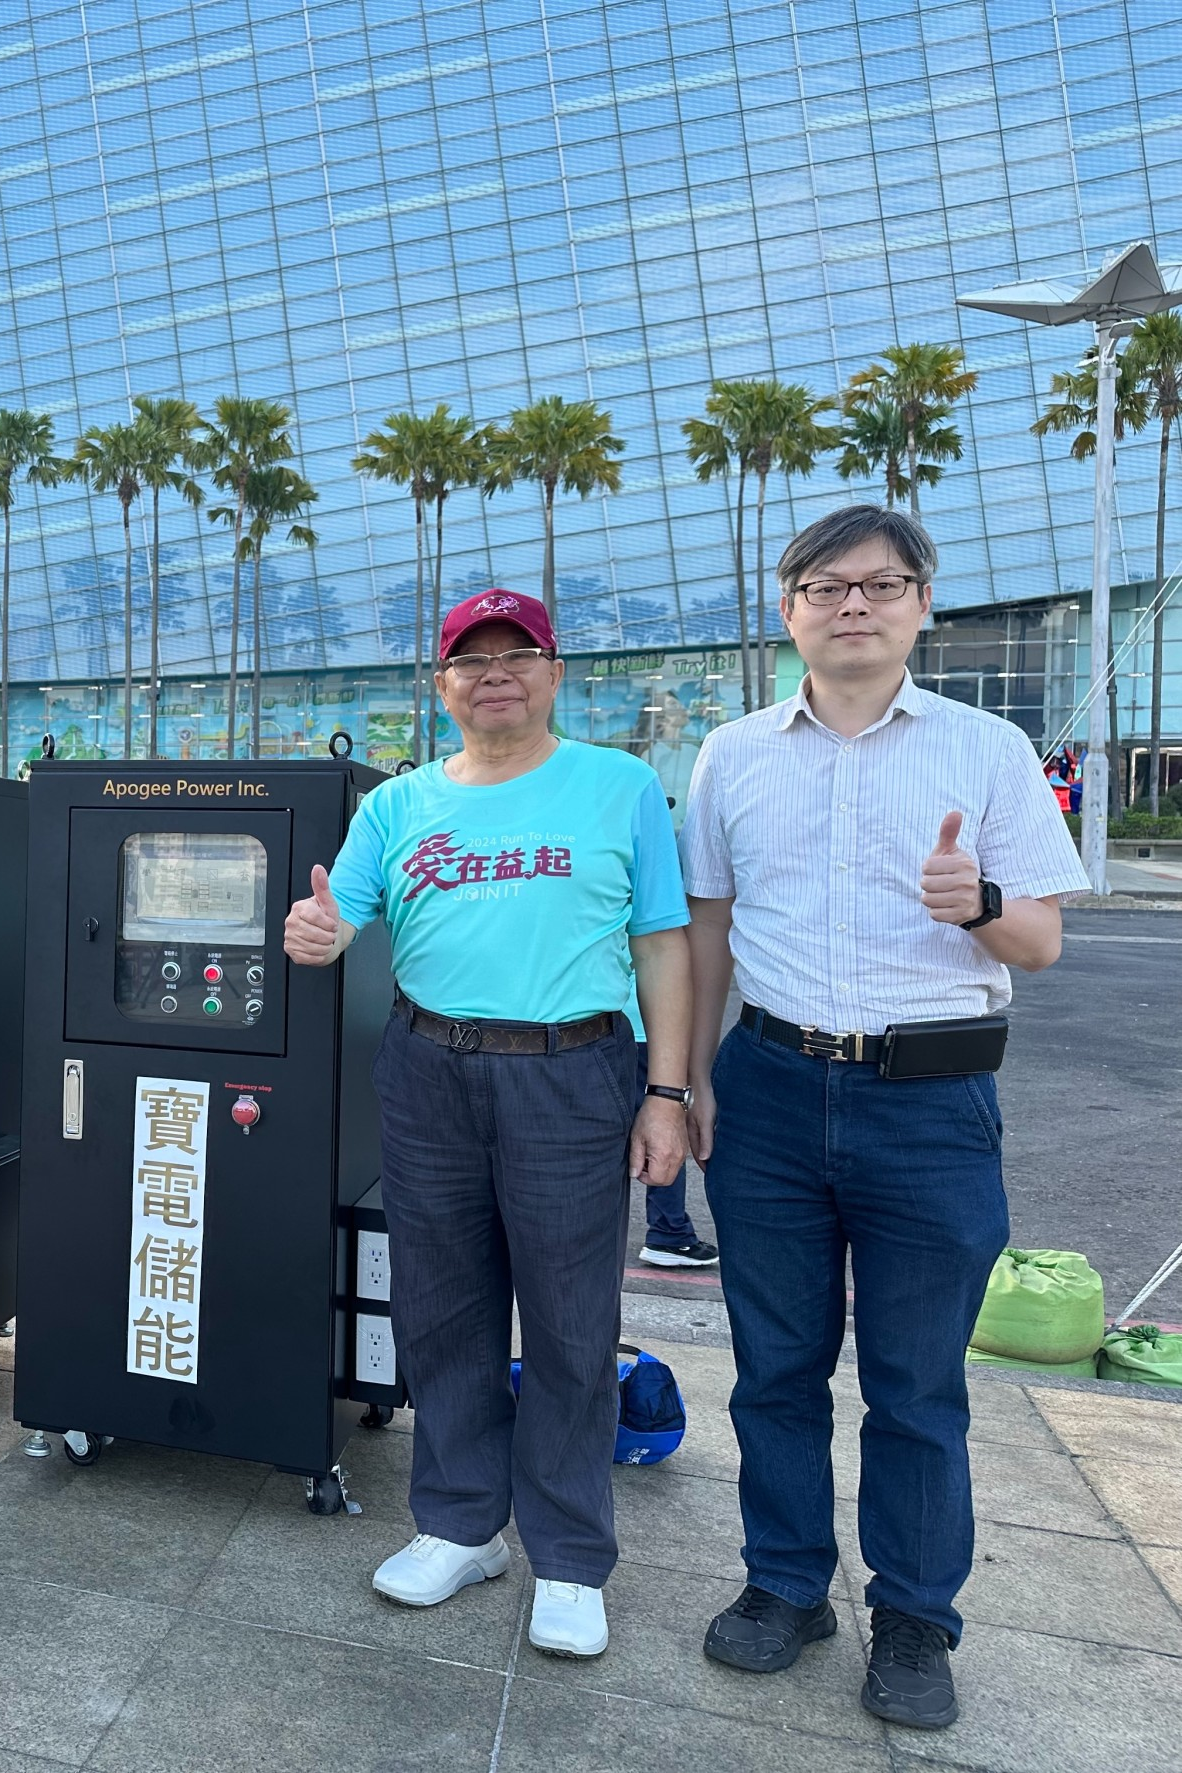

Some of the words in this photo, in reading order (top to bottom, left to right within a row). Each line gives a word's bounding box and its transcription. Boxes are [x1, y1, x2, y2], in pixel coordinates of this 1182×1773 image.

[673, 658, 706, 677] Try
[103, 780, 171, 800] Apogee
[176, 780, 233, 796] Power
[238, 780, 269, 796] Inc.
[467, 837, 497, 848] 2024
[501, 834, 524, 845] Run
[529, 832, 542, 842] To
[546, 832, 576, 844] Love
[453, 885, 499, 902] JOIN
[504, 882, 524, 899] IT
[224, 1082, 257, 1091] Emergency
[133, 1087, 204, 1377] 寶電儲能
